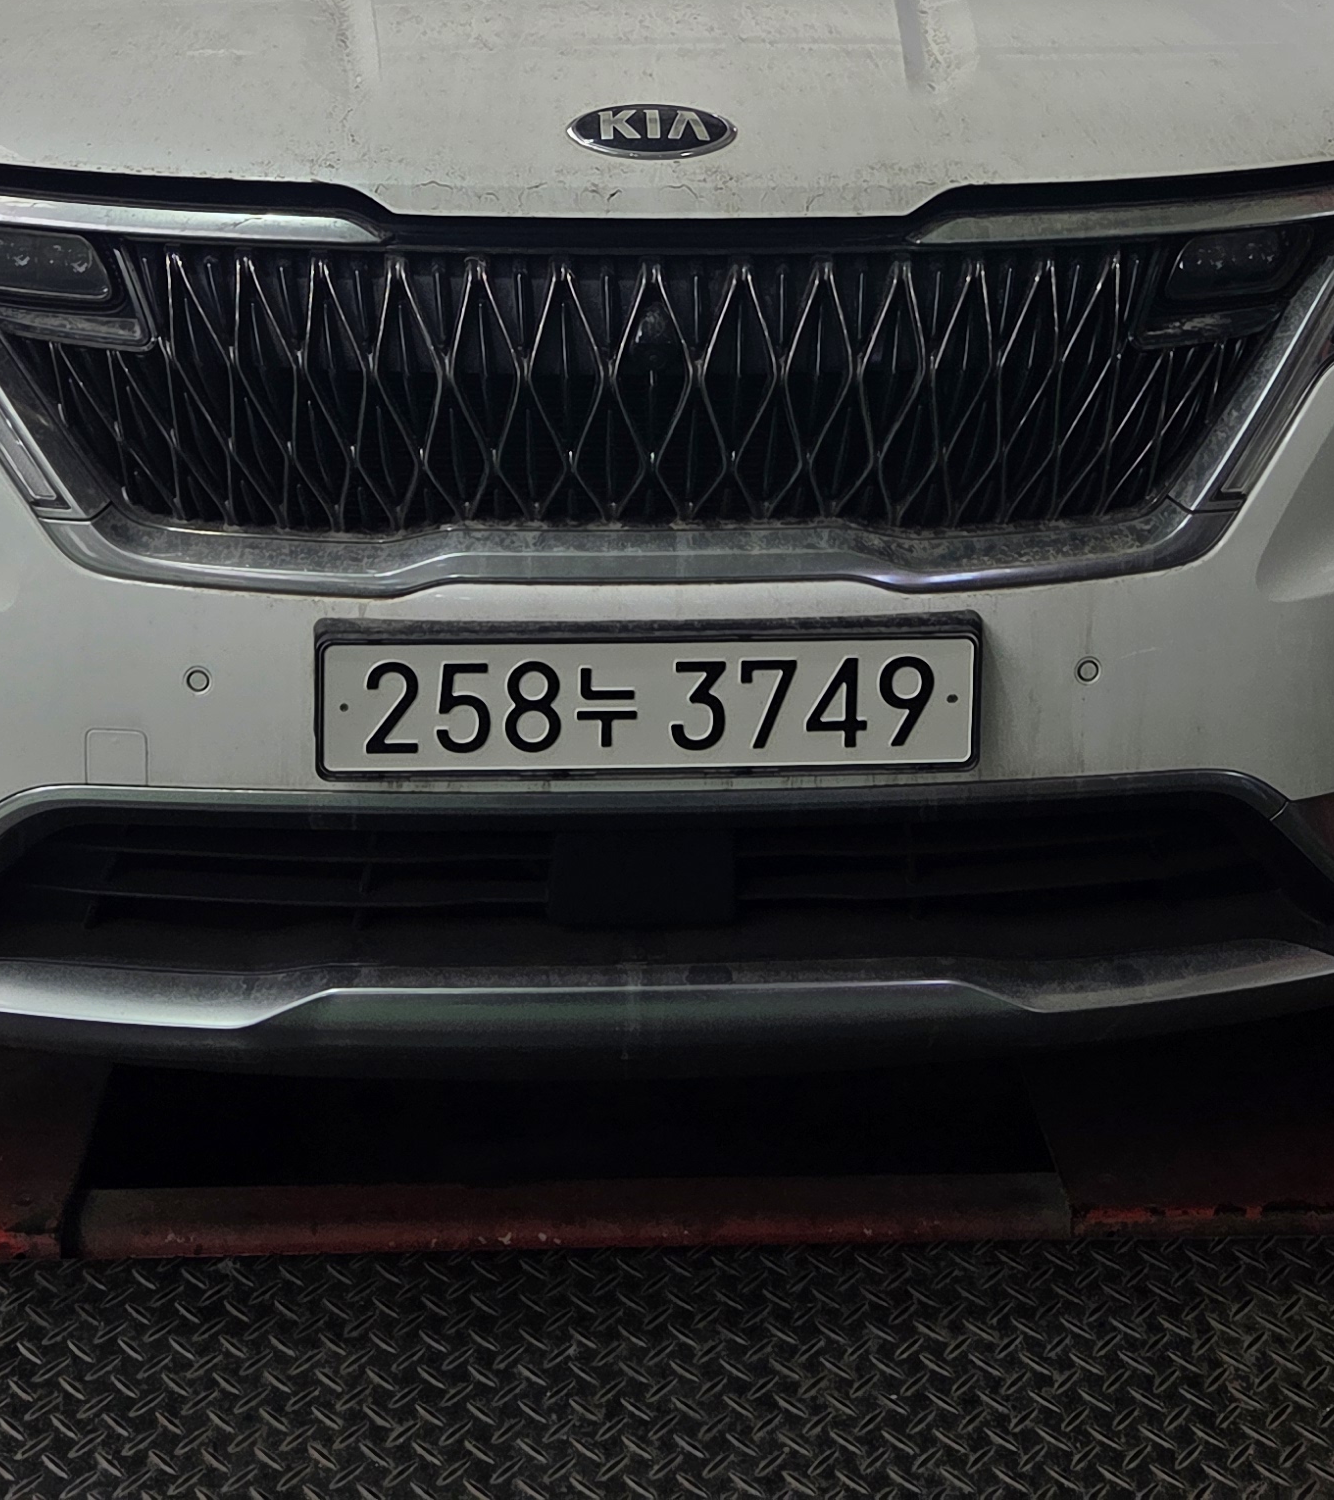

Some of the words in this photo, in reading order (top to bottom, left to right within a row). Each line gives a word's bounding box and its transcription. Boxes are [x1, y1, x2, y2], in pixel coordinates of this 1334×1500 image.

[598, 109, 711, 141] KIA
[365, 660, 638, 755] 258누
[670, 655, 935, 751] 3749
